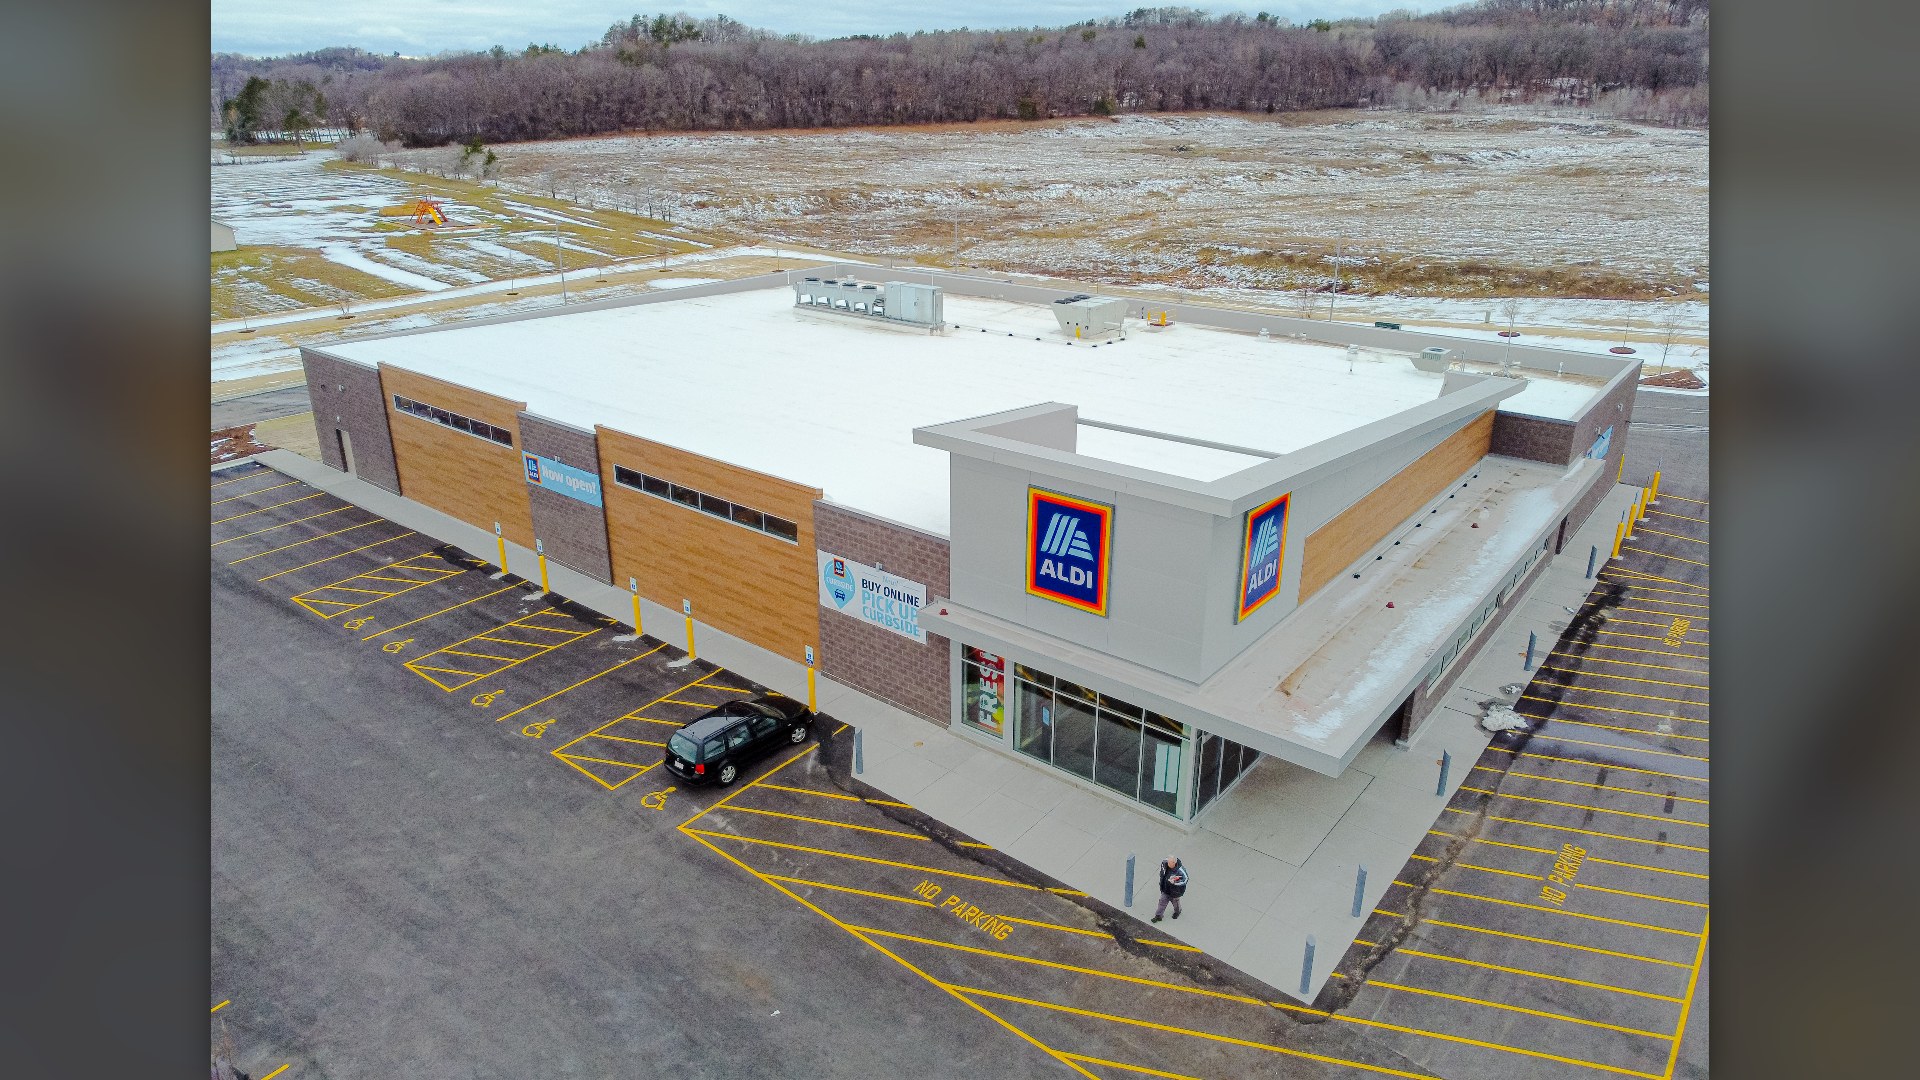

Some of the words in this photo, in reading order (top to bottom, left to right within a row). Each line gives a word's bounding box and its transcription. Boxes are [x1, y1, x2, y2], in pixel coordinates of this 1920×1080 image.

[566, 476, 597, 495] open!
[1040, 559, 1093, 589] ALDI
[1247, 559, 1278, 594] ALDI
[862, 578, 881, 594] BUY
[883, 586, 920, 608] ONLINE
[862, 590, 896, 616] PICK
[901, 603, 918, 622] UP
[862, 606, 920, 637] CURBSIDE
[1548, 843, 1587, 887] PARKING
[913, 880, 942, 900] NO
[940, 895, 1014, 941] PARKING
[1539, 886, 1567, 906] NO
